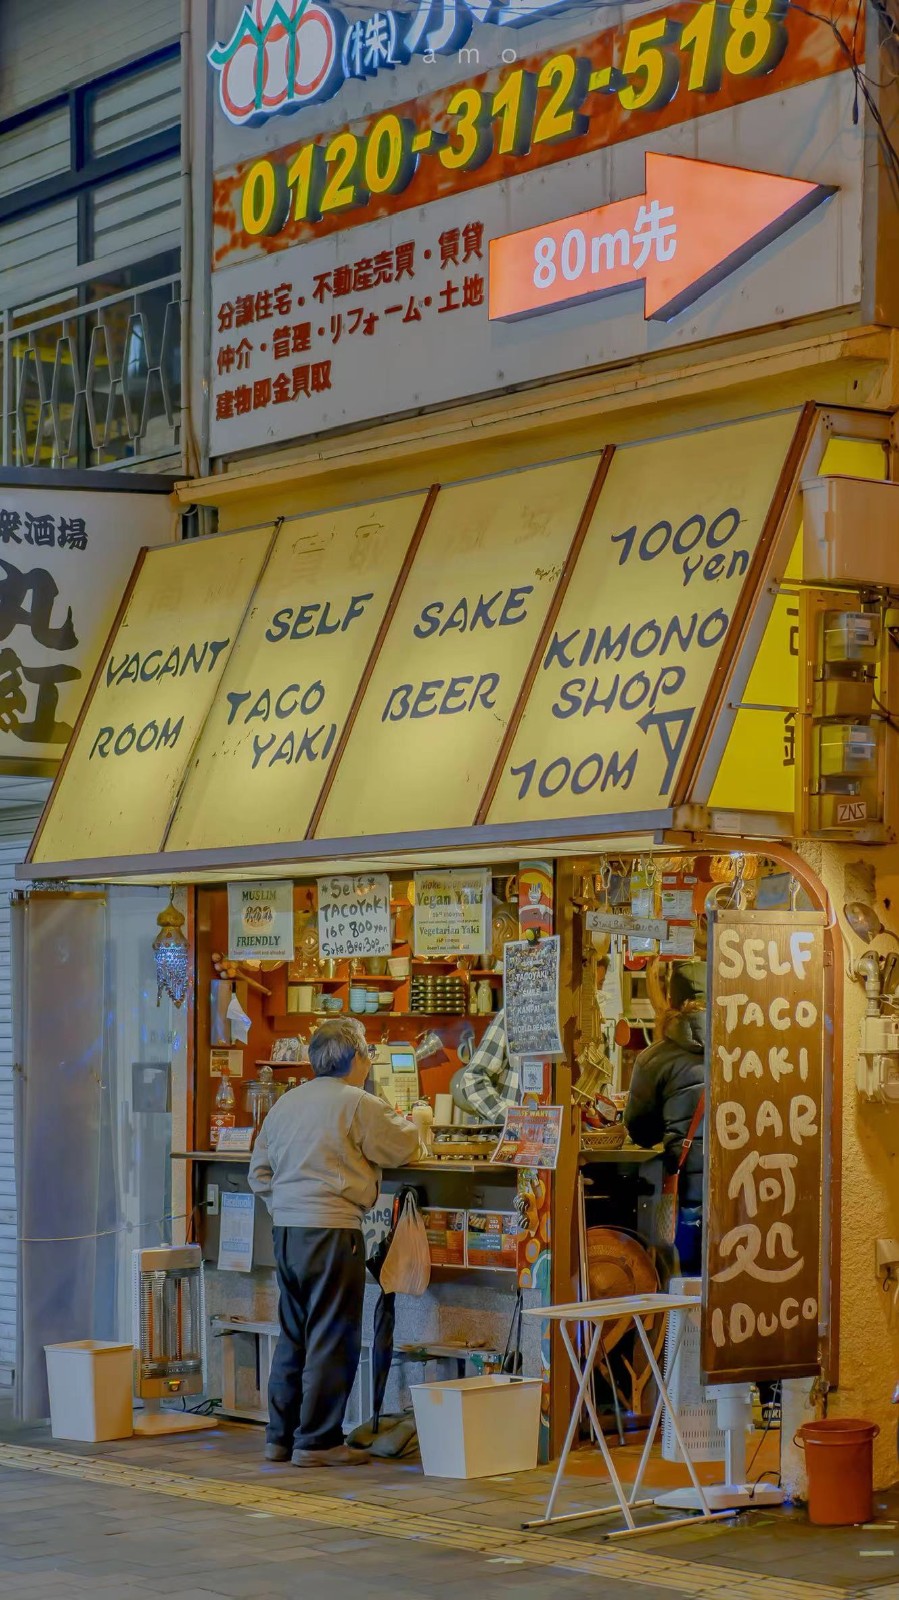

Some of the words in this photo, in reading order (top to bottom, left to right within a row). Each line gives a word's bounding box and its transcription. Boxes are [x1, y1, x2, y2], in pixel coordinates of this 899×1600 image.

[242, 0, 772, 236] 0120-312-518
[533, 200, 677, 289] 80m先
[611, 508, 741, 565] 1000
[682, 550, 750, 587] yen
[265, 592, 374, 643] SELF
[413, 585, 534, 639] SAKE
[106, 637, 230, 688] VACANT
[543, 607, 729, 671] KIMONO
[226, 679, 326, 725] TACO
[381, 672, 501, 722] BEER
[551, 666, 686, 719] SHOP
[89, 715, 185, 760] ROOM
[251, 723, 338, 770] YAKI
[510, 748, 638, 800] 100M
[242, 890, 277, 902] MUSLIM
[416, 892, 451, 909] Vegan
[455, 890, 484, 905] Yaki
[236, 936, 281, 947] FRIENDLY
[419, 926, 459, 936] Vegetarian
[461, 925, 480, 934] Yaki
[718, 929, 816, 981] SELF
[718, 1045, 809, 1084] YAKI
[716, 1095, 818, 1150] BAR
